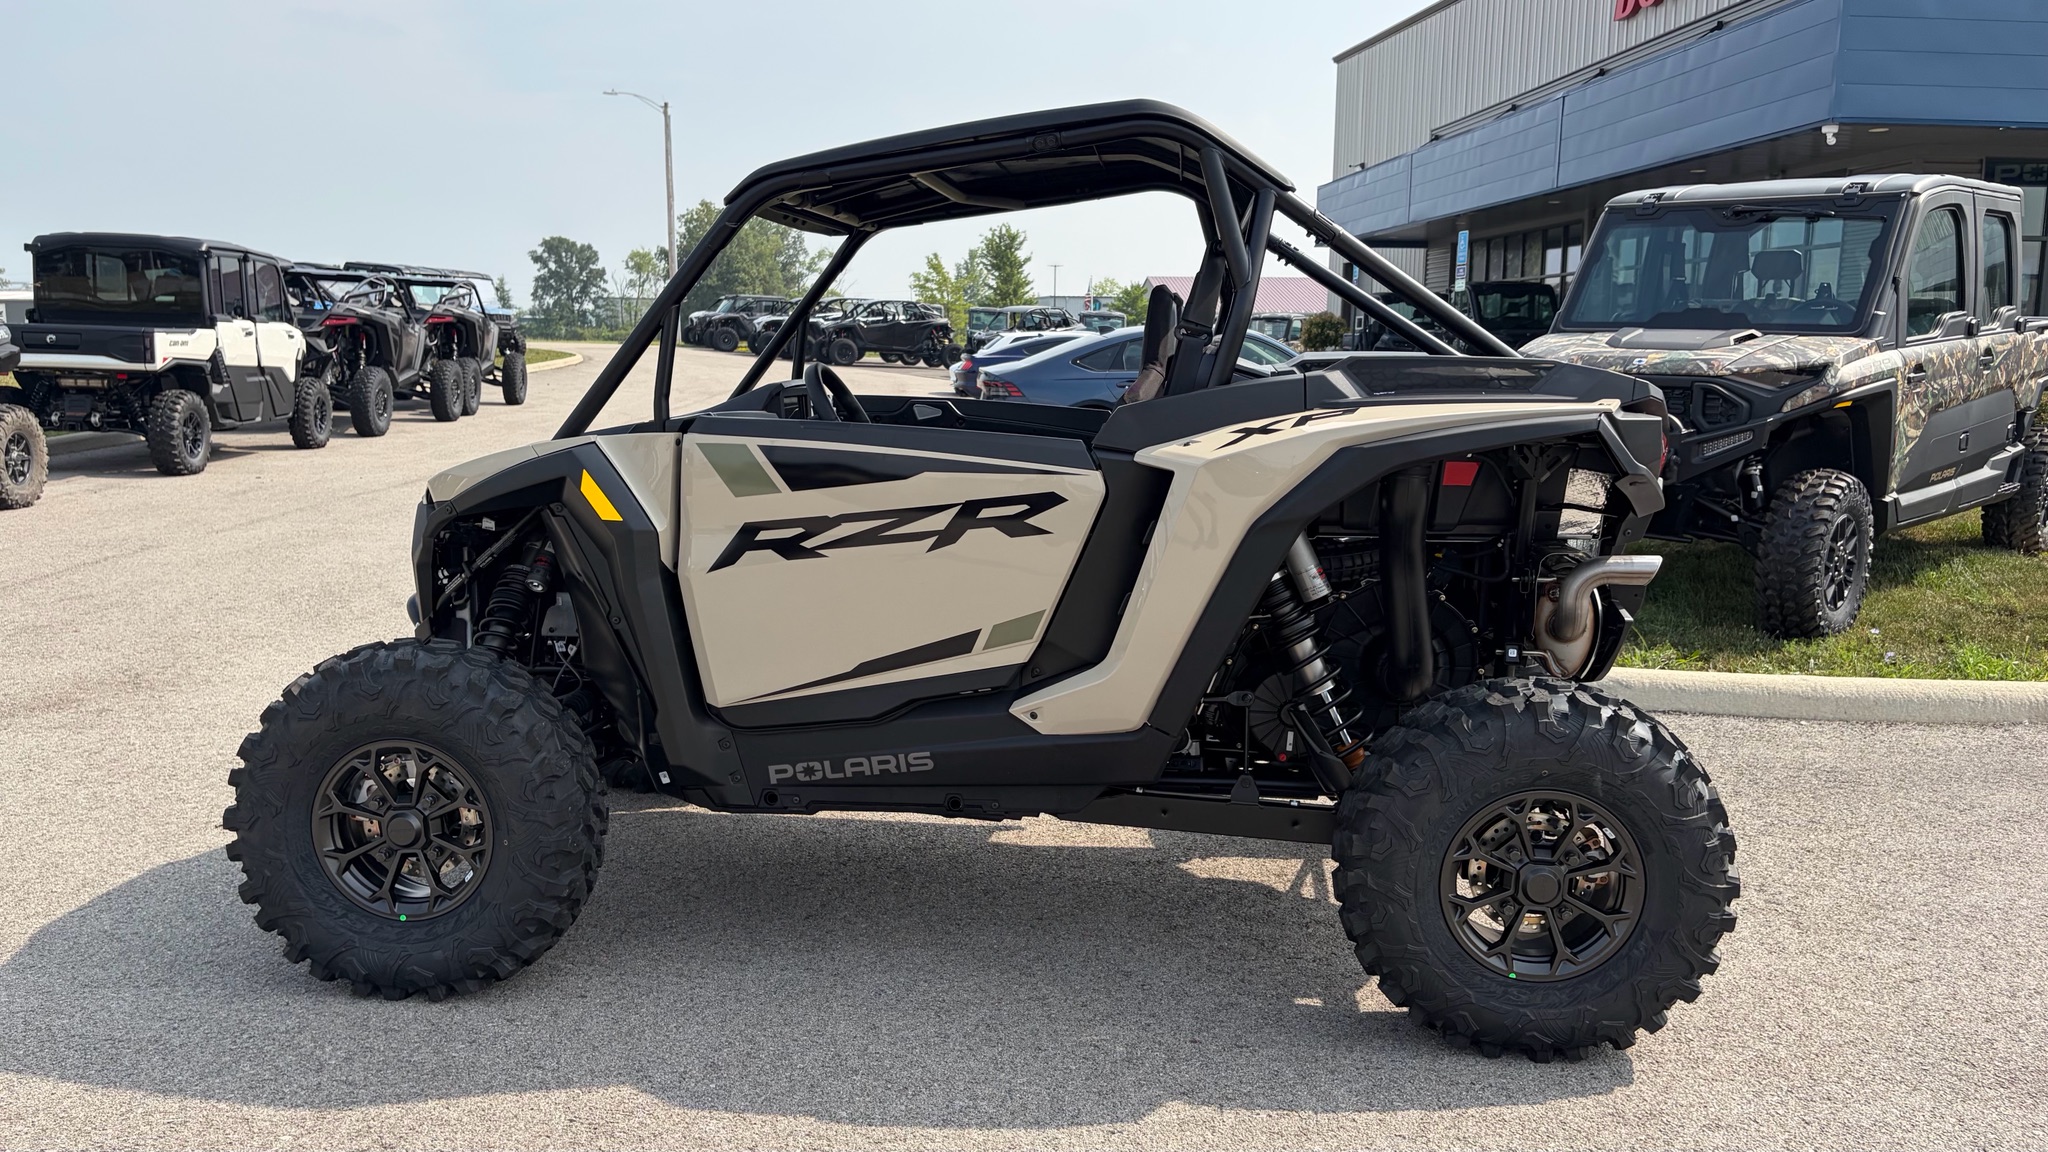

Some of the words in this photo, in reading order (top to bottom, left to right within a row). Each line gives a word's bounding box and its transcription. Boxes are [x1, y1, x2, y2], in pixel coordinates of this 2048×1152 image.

[1211, 406, 1361, 452] XP
[706, 491, 1069, 574] RZR
[768, 751, 935, 785] POLARIS
